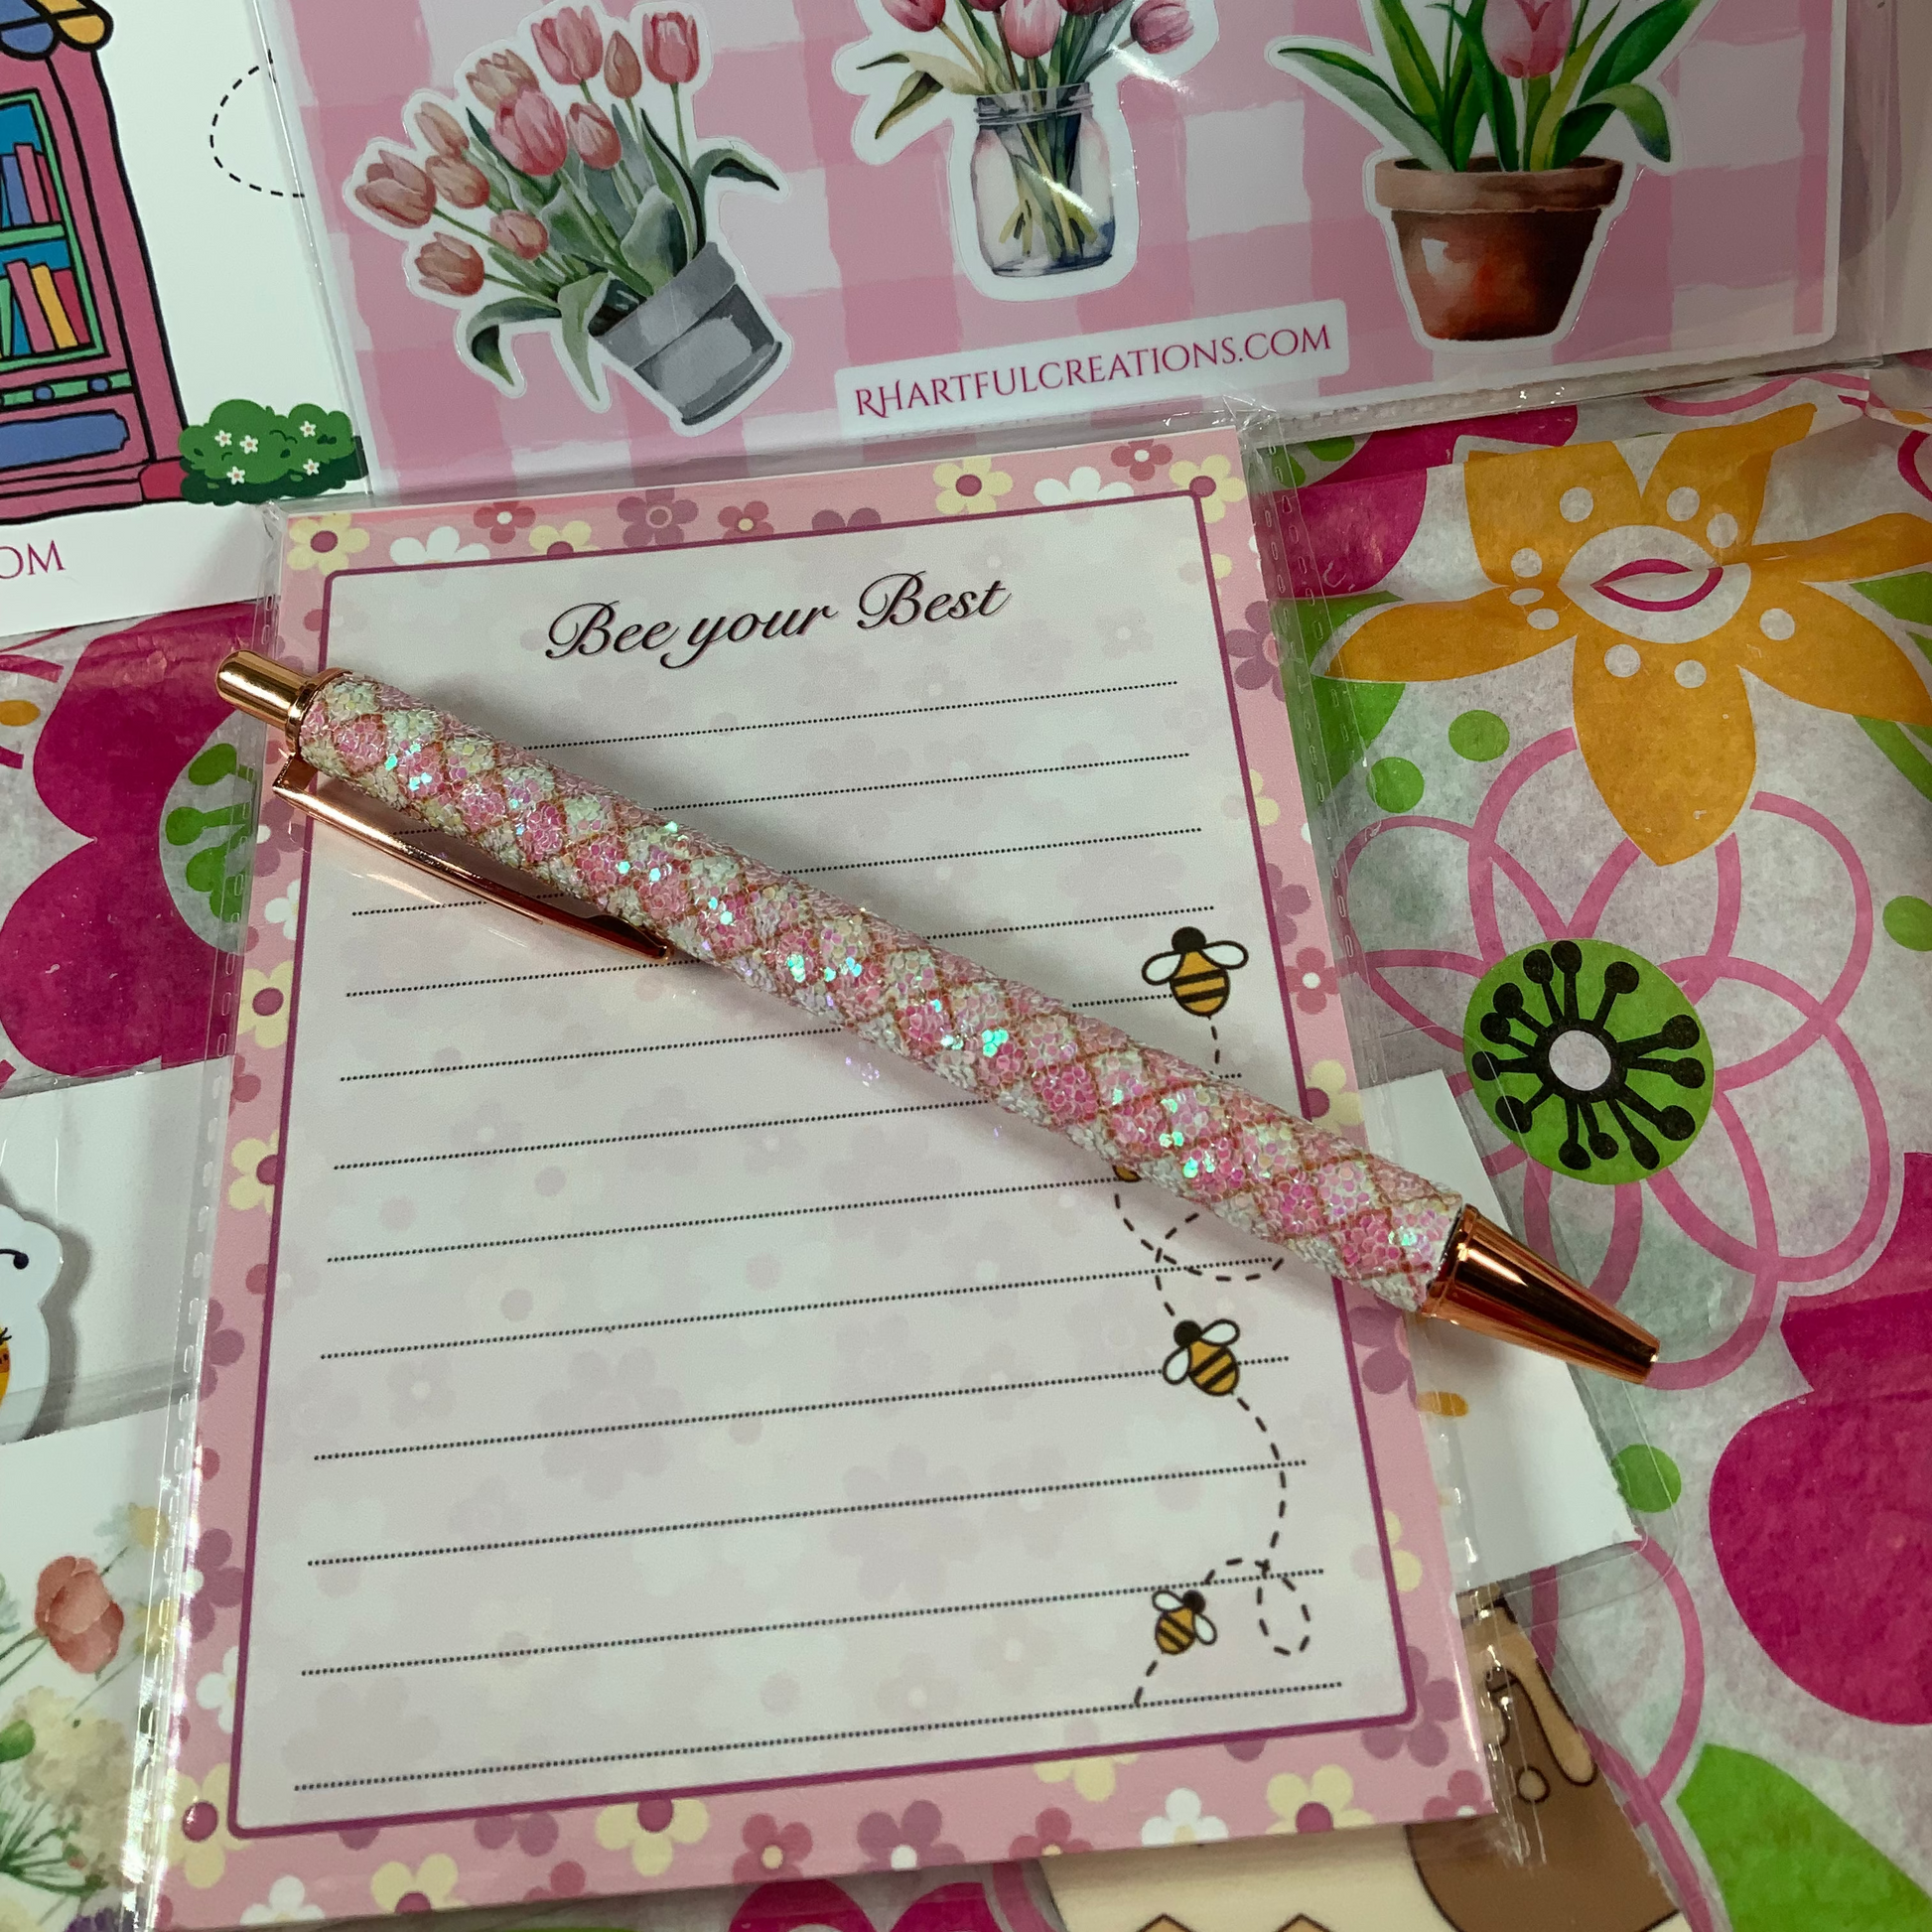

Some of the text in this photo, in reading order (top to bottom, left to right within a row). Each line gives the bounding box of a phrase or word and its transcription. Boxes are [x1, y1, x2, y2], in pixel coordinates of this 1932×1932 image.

[855, 325, 1331, 418] RHARTFULCREATIONS.COM
[545, 570, 1013, 670] Bee your Best
